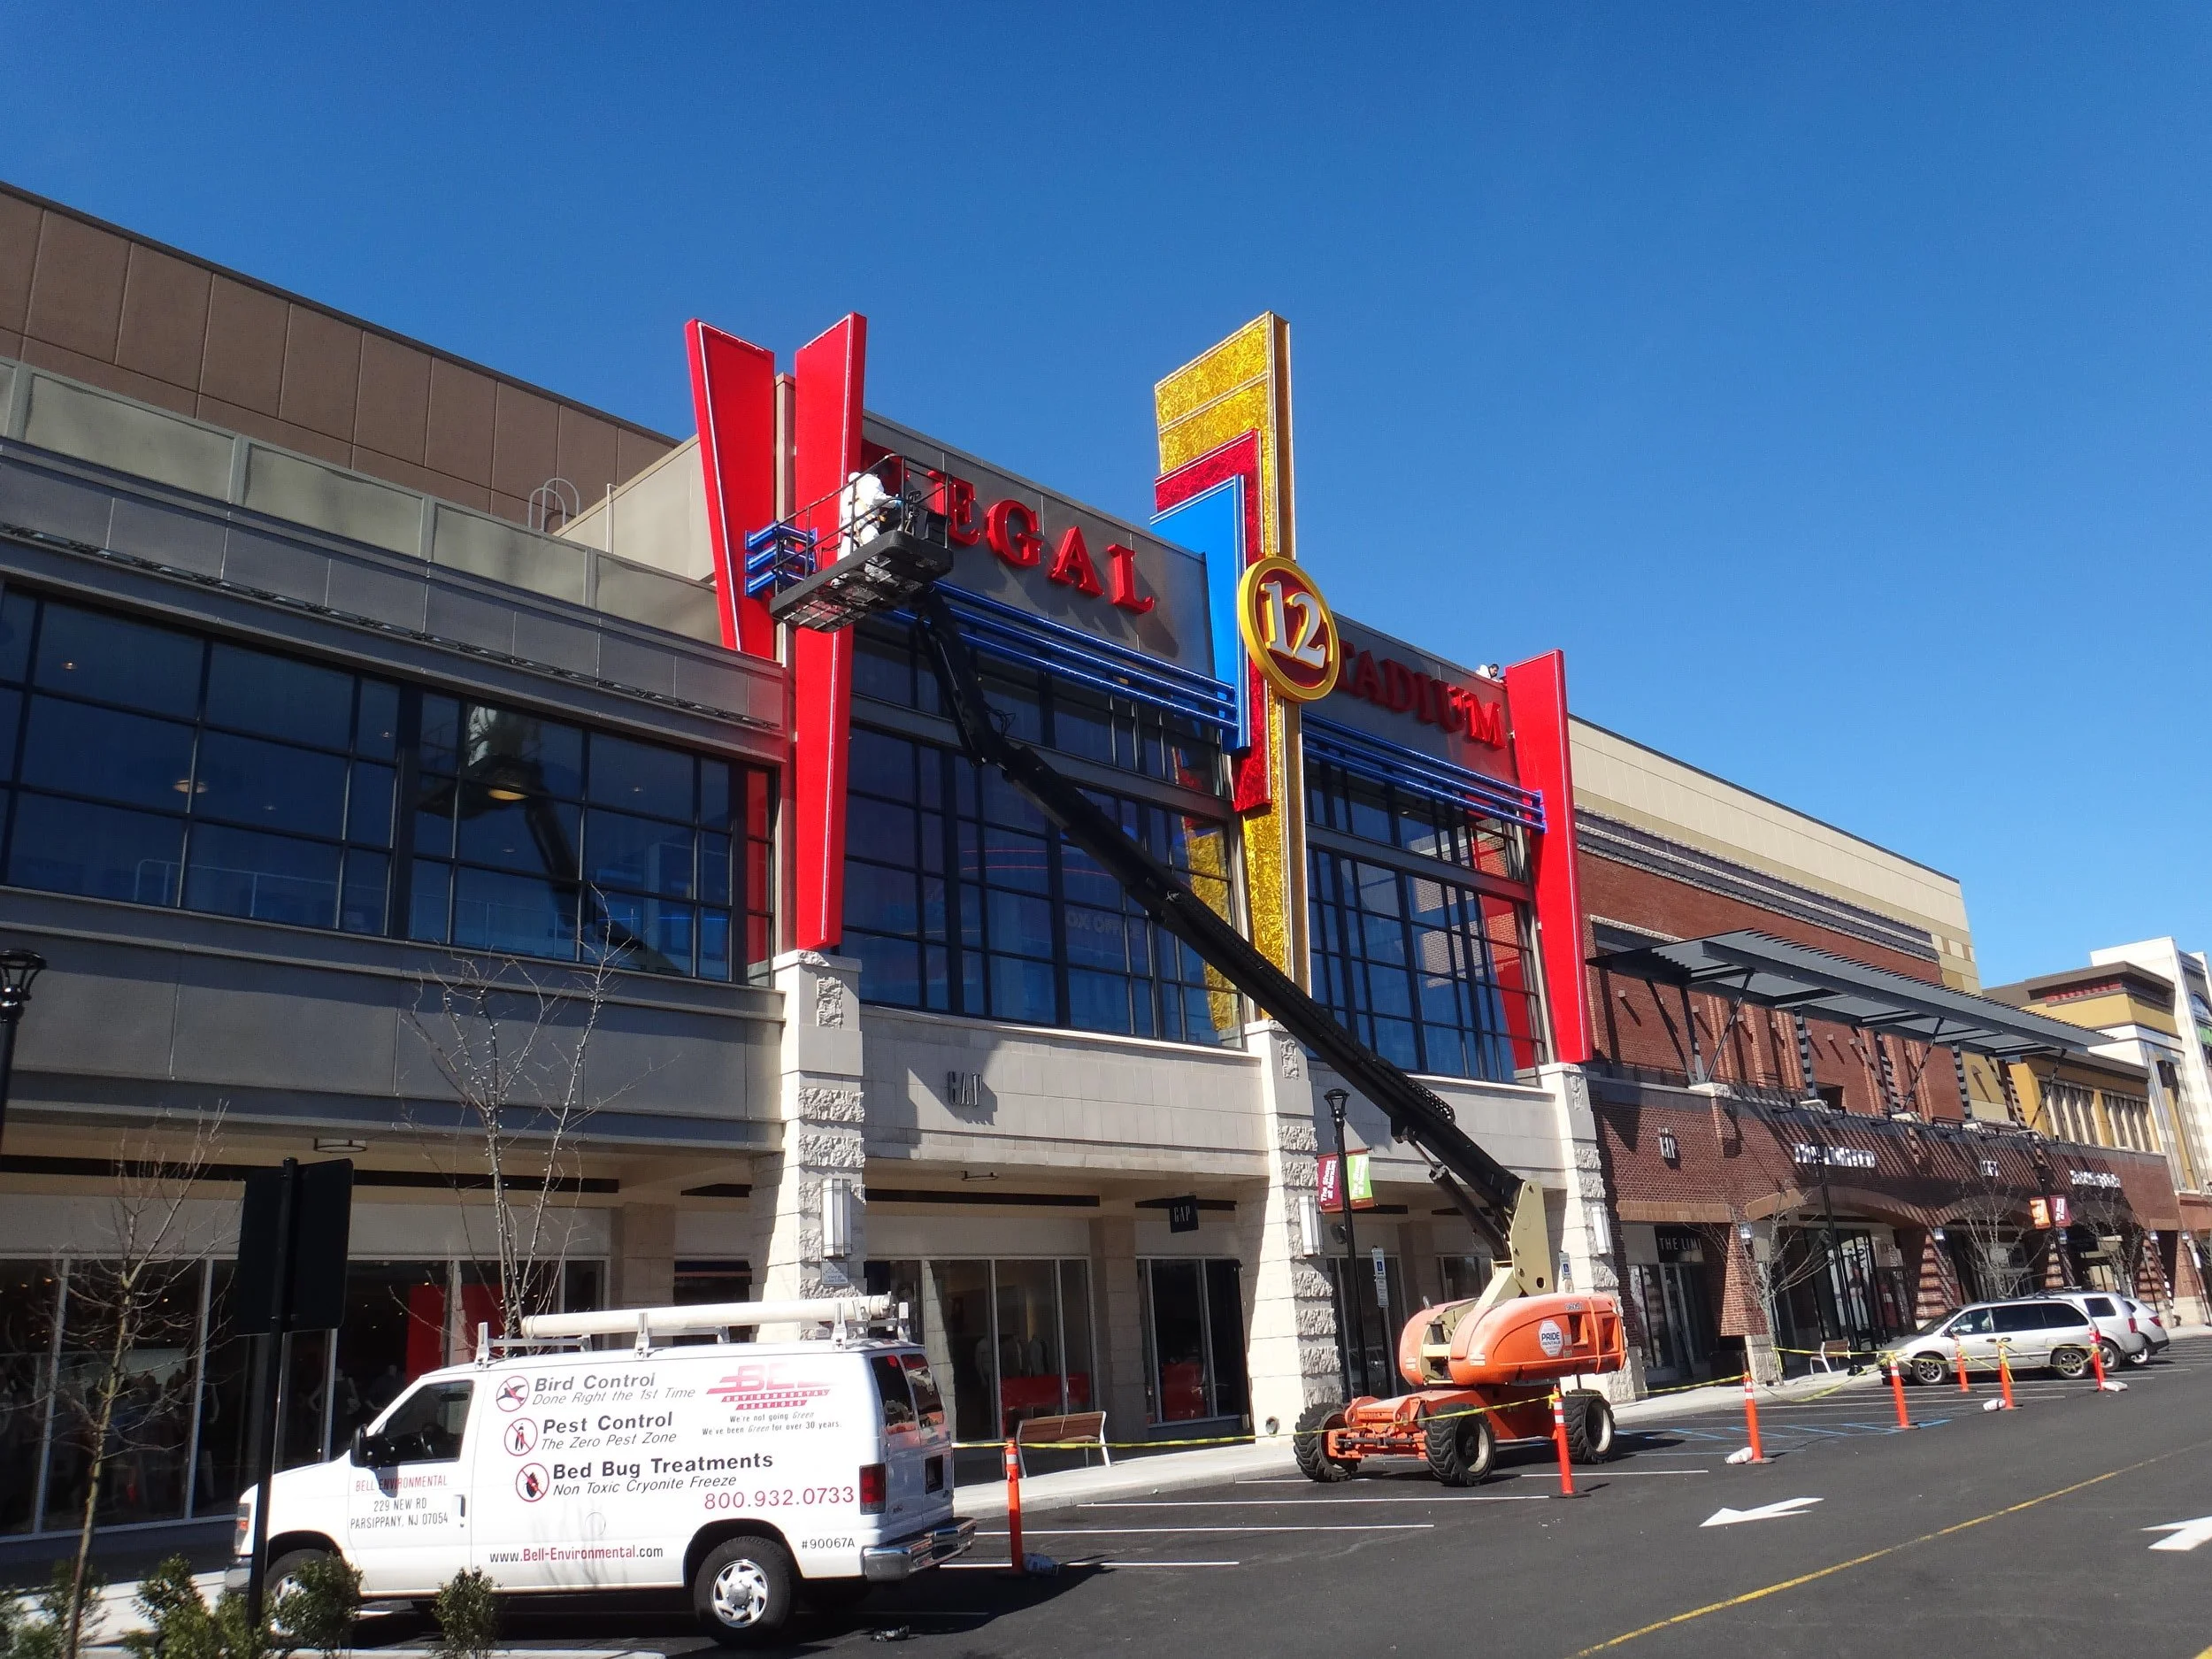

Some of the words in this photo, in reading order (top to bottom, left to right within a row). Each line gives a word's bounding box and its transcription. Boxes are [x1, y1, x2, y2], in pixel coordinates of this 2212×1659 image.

[1260, 580, 1325, 669] 12
[1336, 640, 1507, 749] TADIUM
[1173, 1205, 1191, 1223] GAP
[1660, 1238, 1678, 1250] THE
[1541, 1332, 1560, 1340] PRIDE
[534, 1377, 574, 1392] Bird
[583, 1372, 656, 1390] Control
[532, 1394, 567, 1405] Done
[572, 1390, 607, 1405] Right
[611, 1390, 634, 1402] the
[641, 1388, 658, 1400] 1st
[664, 1386, 695, 1399] Time
[543, 1417, 588, 1434] Pest
[597, 1411, 672, 1431] Control
[769, 1413, 789, 1422] going
[703, 1426, 724, 1435] We've
[818, 1420, 841, 1429] years.
[541, 1438, 569, 1451] The
[569, 1435, 601, 1449] Zero
[605, 1433, 638, 1447] Pest
[641, 1432, 677, 1444] Zone
[553, 1463, 592, 1479] Bed
[602, 1461, 641, 1479] Bug
[650, 1453, 773, 1474] Treatments
[356, 1479, 375, 1492] BELL
[379, 1475, 448, 1491] ENVIRONMENTAL
[553, 1484, 580, 1495] Non
[587, 1482, 619, 1494] Toxic
[626, 1478, 684, 1494] Cryonite
[689, 1475, 737, 1488] Freeze
[373, 1500, 389, 1512] 229
[394, 1498, 411, 1510] NEW
[416, 1497, 427, 1509] RD
[704, 1486, 854, 1509] 800.932.0733
[350, 1515, 404, 1529] PARSIPPANY,
[408, 1514, 419, 1525] NJ
[422, 1512, 448, 1525] 07054
[802, 1538, 856, 1549] #90067A
[489, 1545, 663, 1563] www.Bell-Environmental.com
